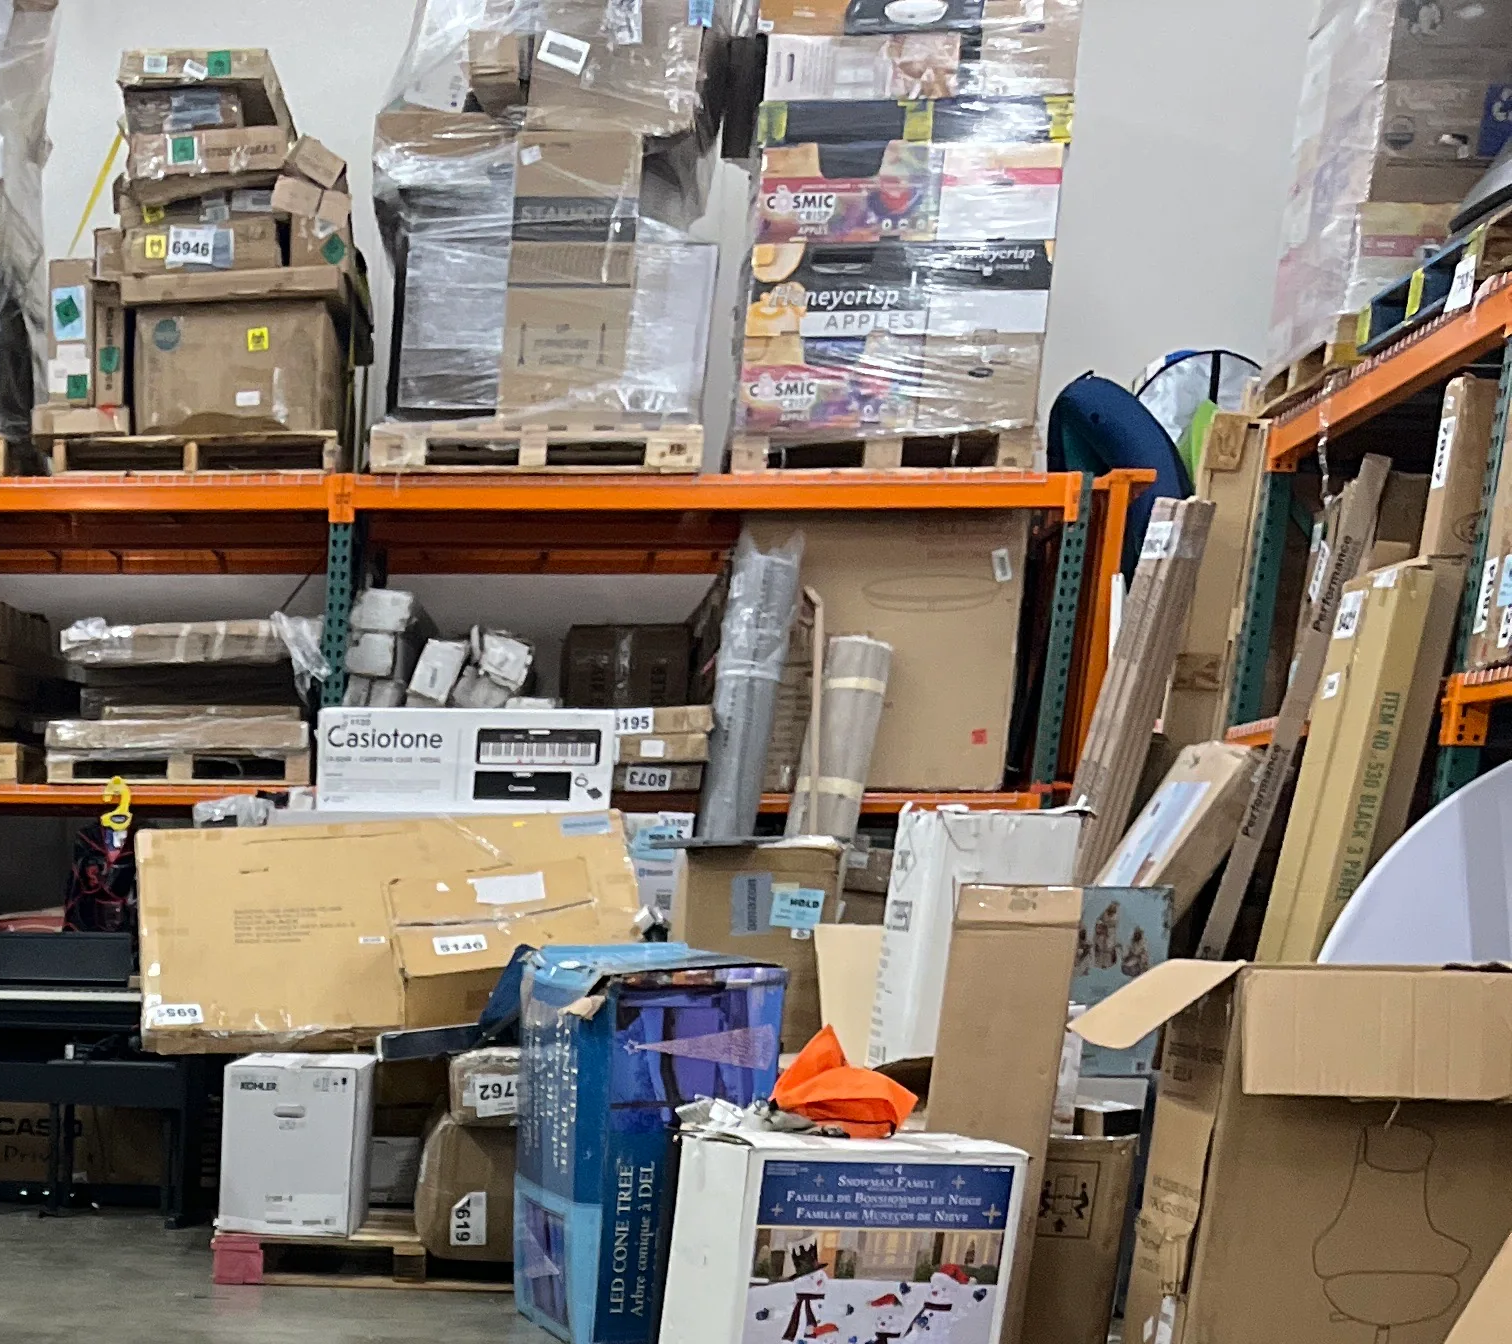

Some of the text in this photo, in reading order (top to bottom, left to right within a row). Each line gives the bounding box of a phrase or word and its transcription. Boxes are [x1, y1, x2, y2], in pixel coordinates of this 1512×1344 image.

[172, 240, 209, 257] 6946
[769, 284, 899, 311] Honeycrisp
[824, 312, 916, 330] APPLES
[1312, 536, 1353, 633] Performance
[1378, 691, 1401, 727] ITEM
[327, 725, 443, 749] Casiotone
[629, 770, 668, 787] 8073
[1359, 761, 1385, 790] 530
[1241, 744, 1282, 838] Performance
[1350, 794, 1379, 840] BLACK
[1349, 846, 1364, 859] 3
[790, 898, 820, 909] HOLD
[240, 1082, 277, 1091] KOHLER
[478, 1081, 518, 1101] 762
[638, 1160, 656, 1198] DEL
[787, 1190, 834, 1203] FAMILLE
[837, 1194, 851, 1204] DE
[796, 1206, 840, 1220] FAMILIA
[844, 1211, 858, 1220] DE
[918, 1213, 931, 1222] DE
[935, 1210, 969, 1223] NIEVE
[609, 1165, 634, 1315] LED CONE TREE
[638, 1216, 654, 1271] conique
[630, 1276, 648, 1317] Arbre
